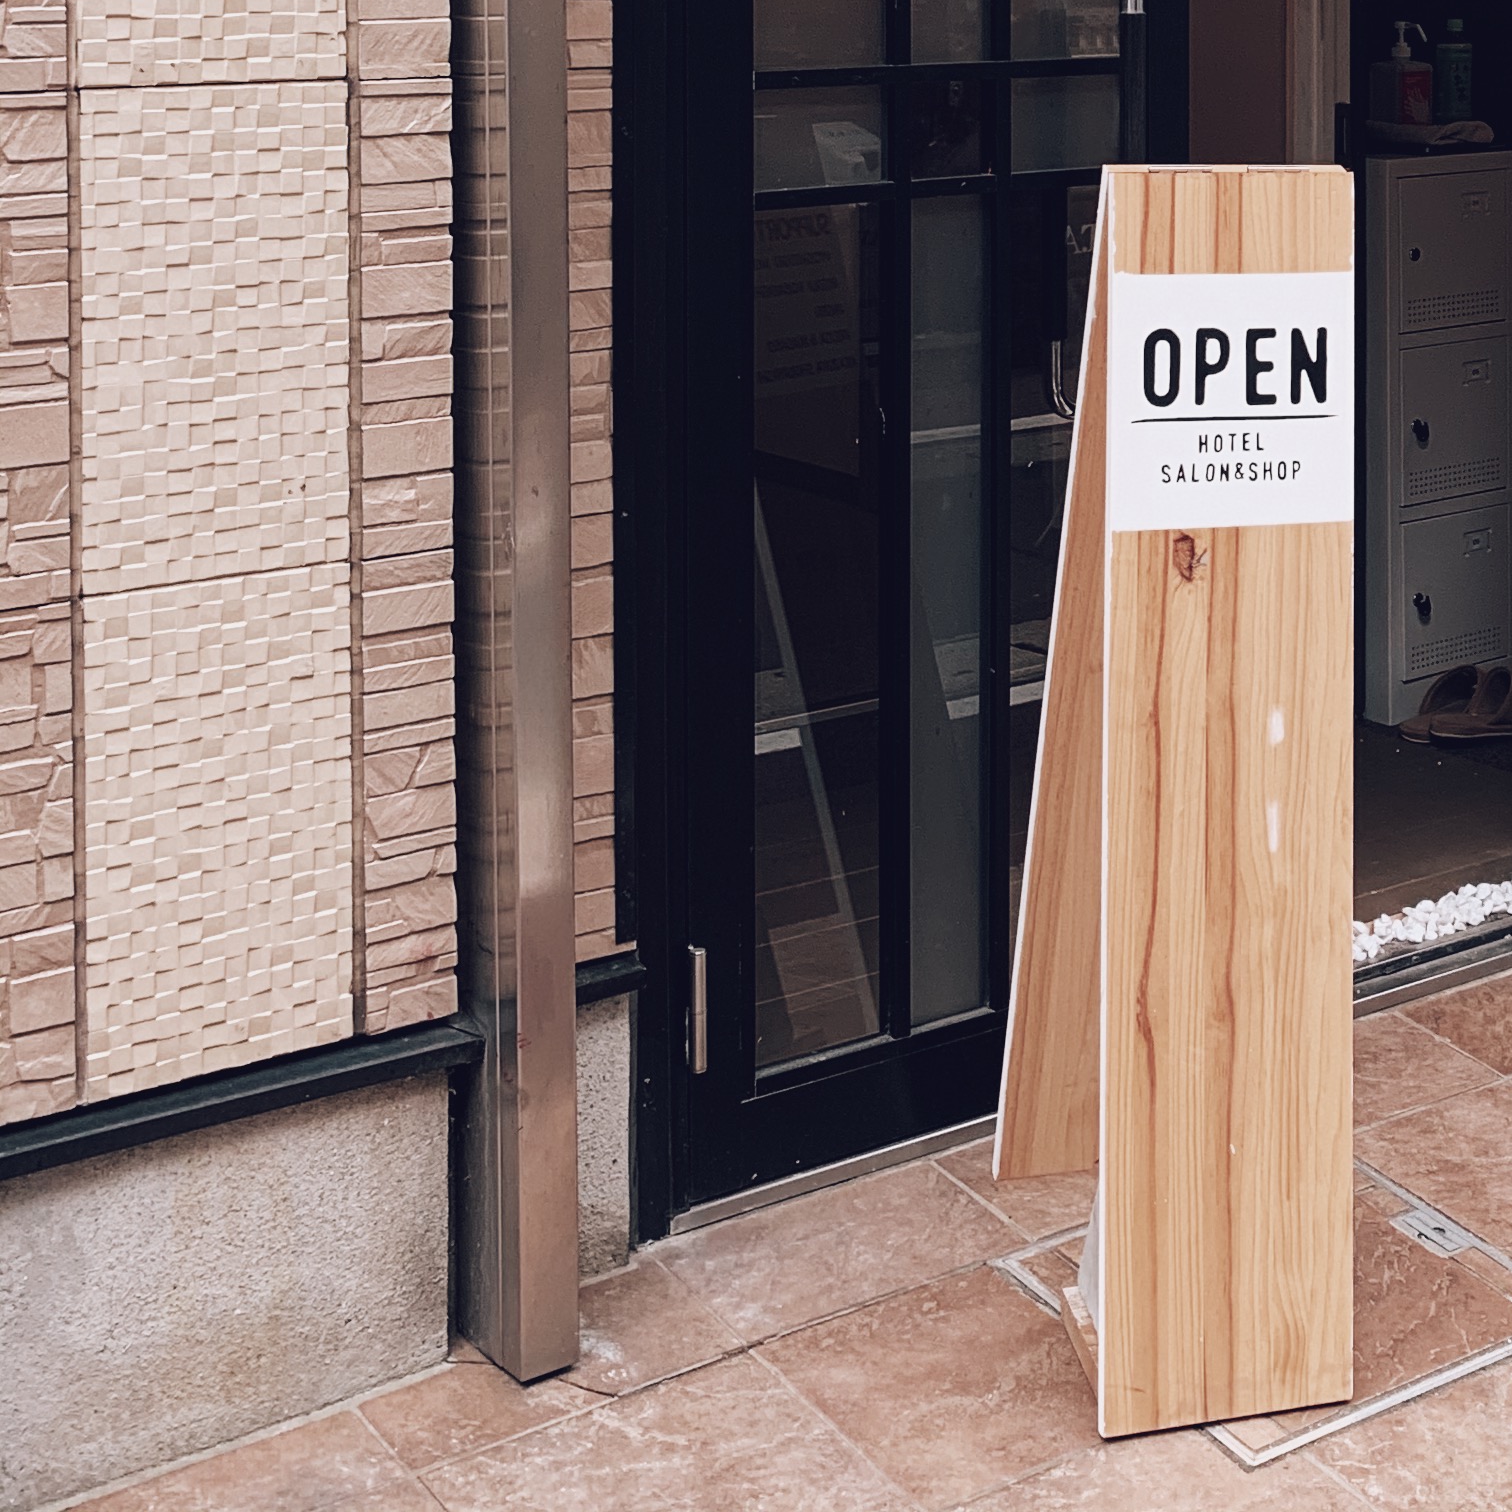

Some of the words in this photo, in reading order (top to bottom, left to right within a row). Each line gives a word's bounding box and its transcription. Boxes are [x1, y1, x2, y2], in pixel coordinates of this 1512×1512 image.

[1143, 326, 1328, 407] OPEN
[1198, 432, 1265, 453] HOTEL
[1161, 460, 1302, 483] SALON&SHOP
